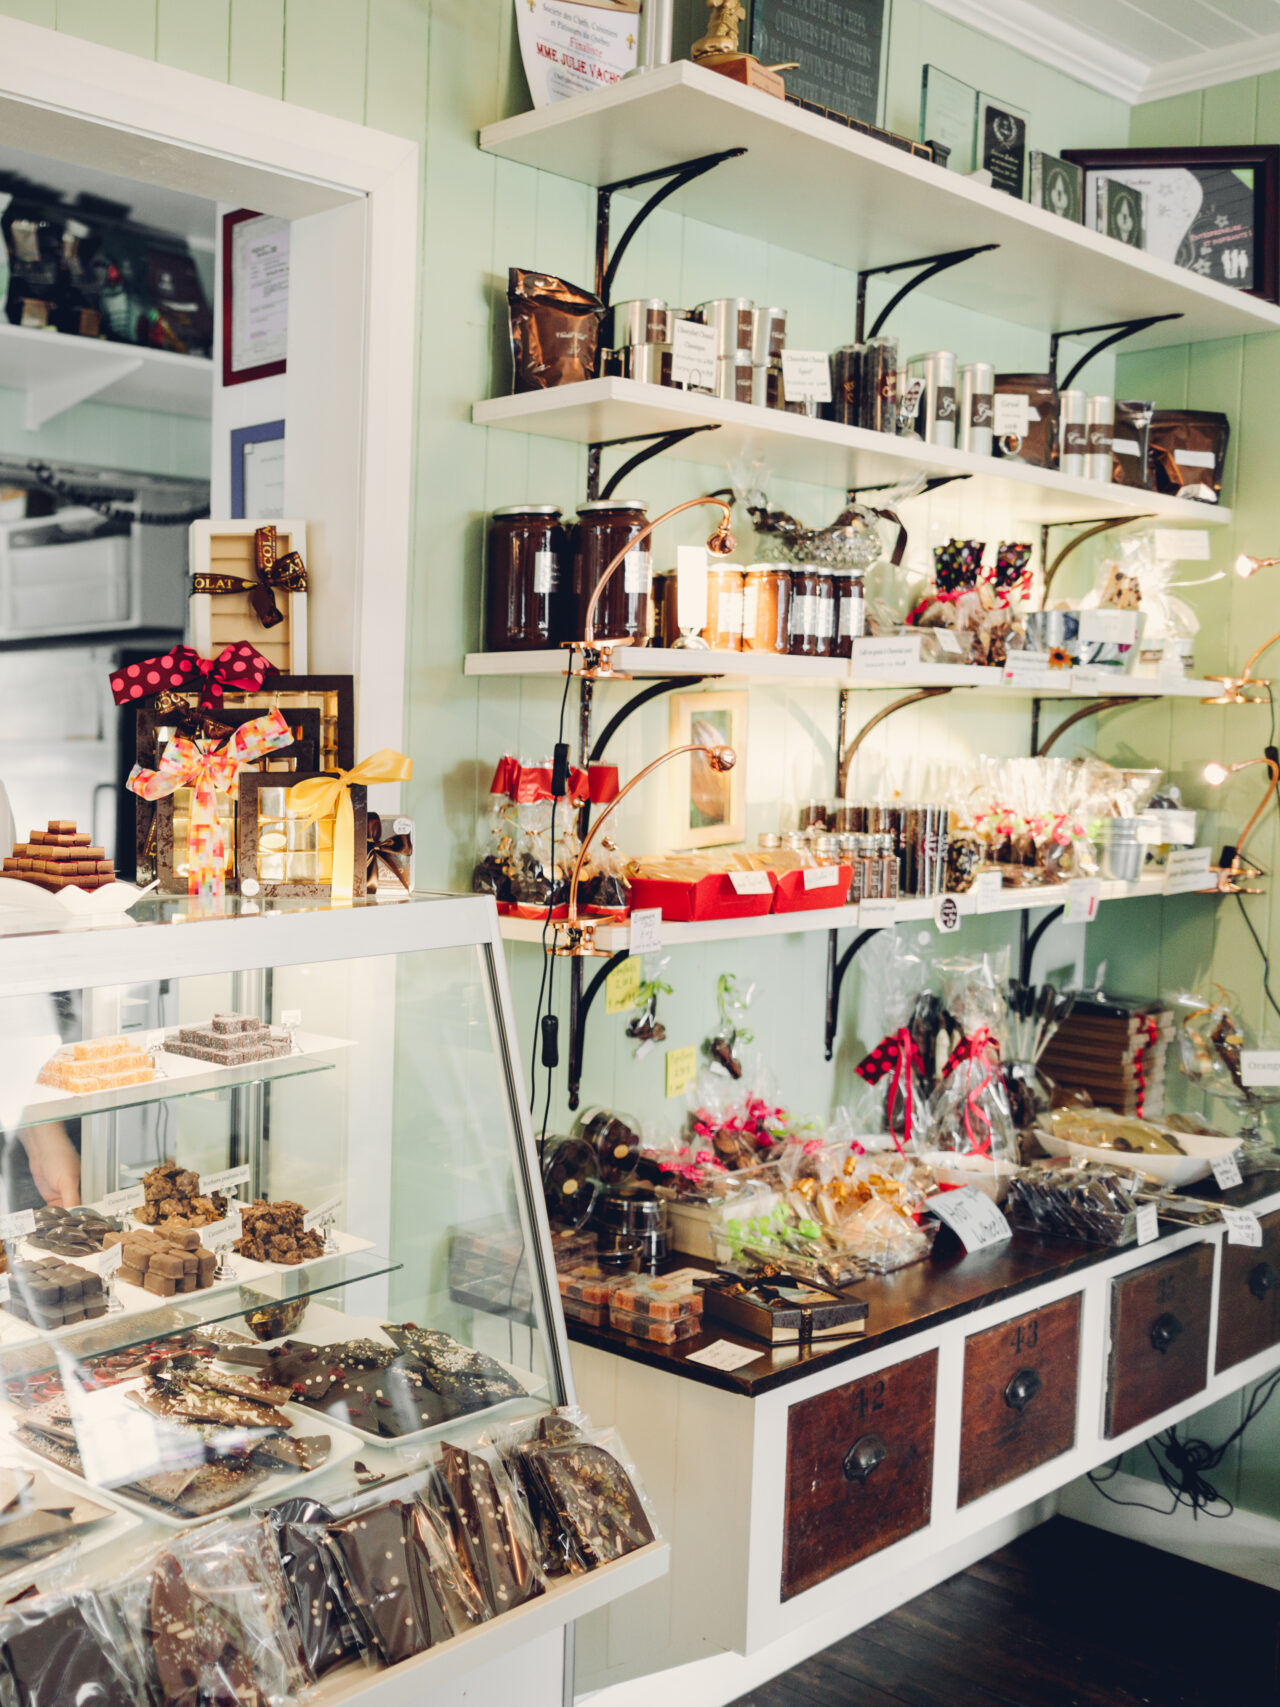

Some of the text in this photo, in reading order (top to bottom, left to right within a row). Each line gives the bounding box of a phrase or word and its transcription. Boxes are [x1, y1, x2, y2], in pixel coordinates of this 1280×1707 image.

[536, 42, 558, 63] MME
[560, 52, 587, 75] JULIE
[1010, 1319, 1039, 1354] 43
[851, 1380, 886, 1419] 42
